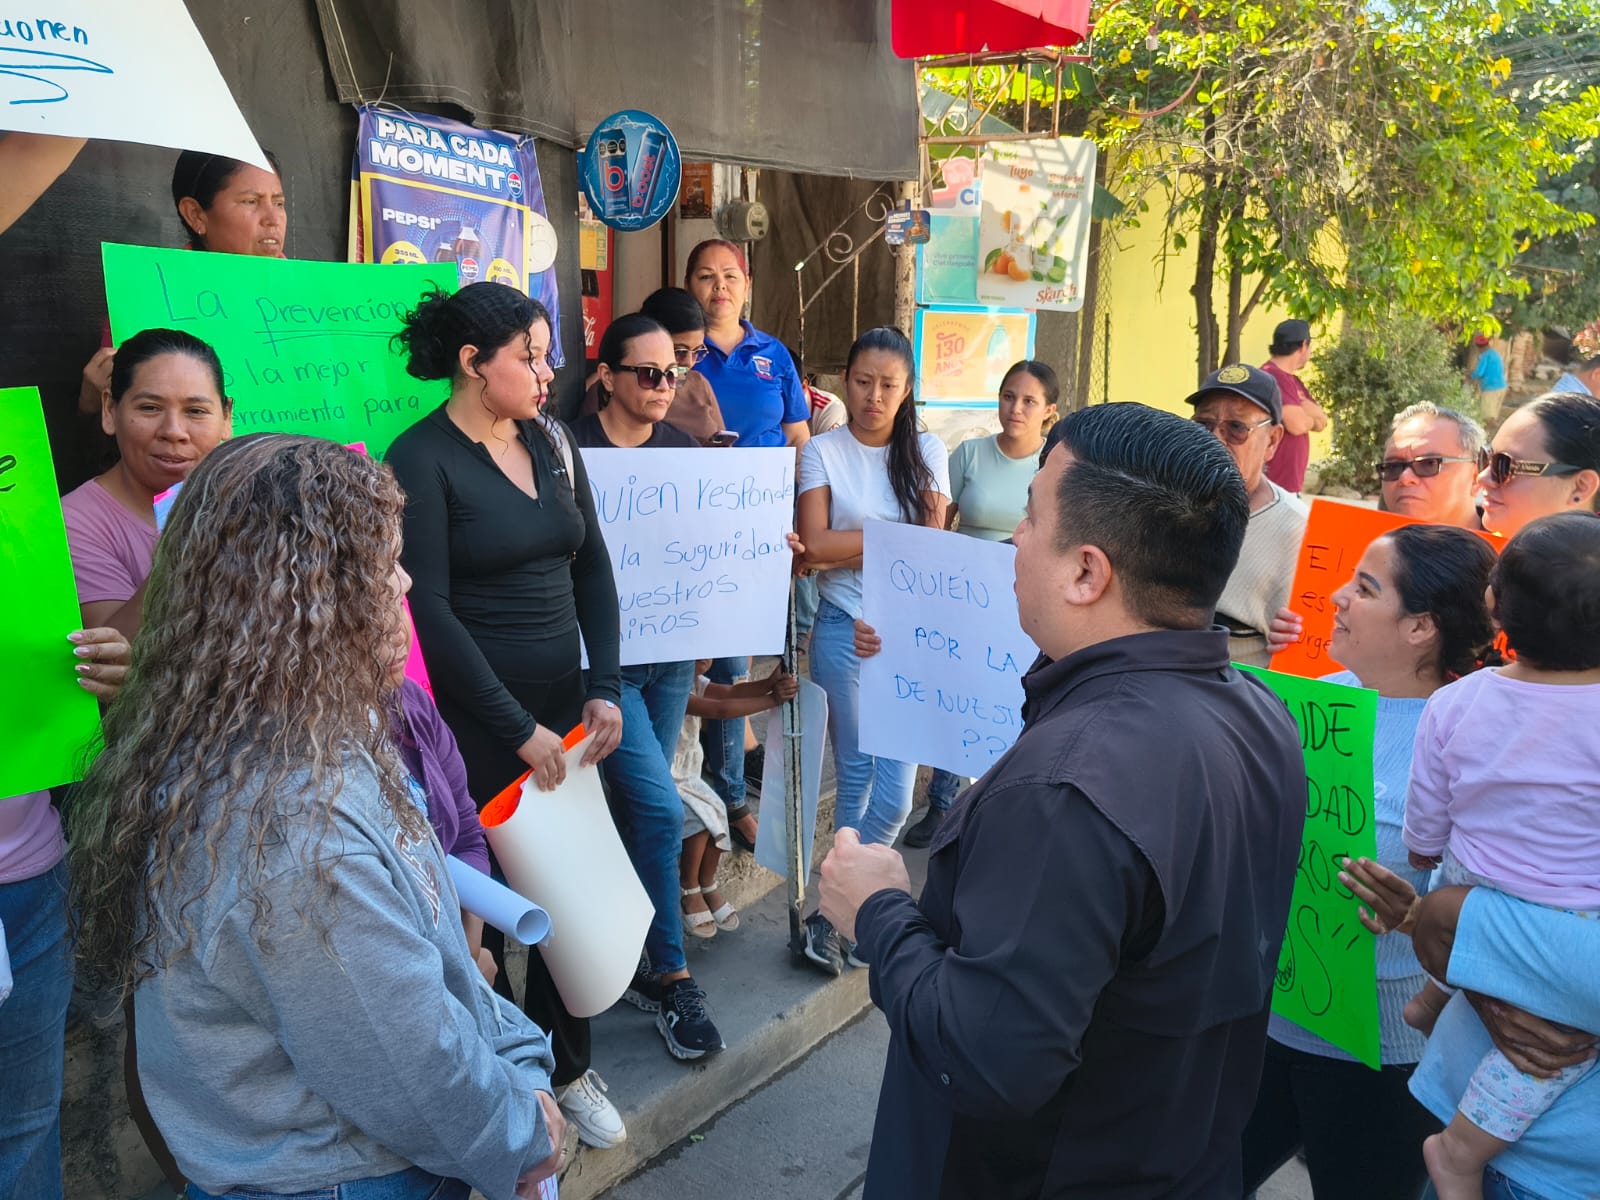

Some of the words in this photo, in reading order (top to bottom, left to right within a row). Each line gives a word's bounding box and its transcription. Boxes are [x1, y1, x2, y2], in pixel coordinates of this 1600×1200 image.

[376, 115, 449, 153] PARA
[450, 135, 515, 168] CADA
[155, 262, 229, 322] La
[935, 336, 966, 360] 130
[244, 358, 284, 386] la
[293, 359, 369, 387] mejor
[363, 394, 420, 427] para
[588, 474, 680, 523] uien
[620, 543, 640, 571] la
[618, 574, 739, 612] uestros
[890, 559, 990, 609] QUIÉN
[620, 611, 700, 643] iños
[915, 626, 962, 660] POR
[986, 646, 1019, 673] LA
[894, 673, 926, 702] DE
[937, 688, 1026, 728] NUEST
